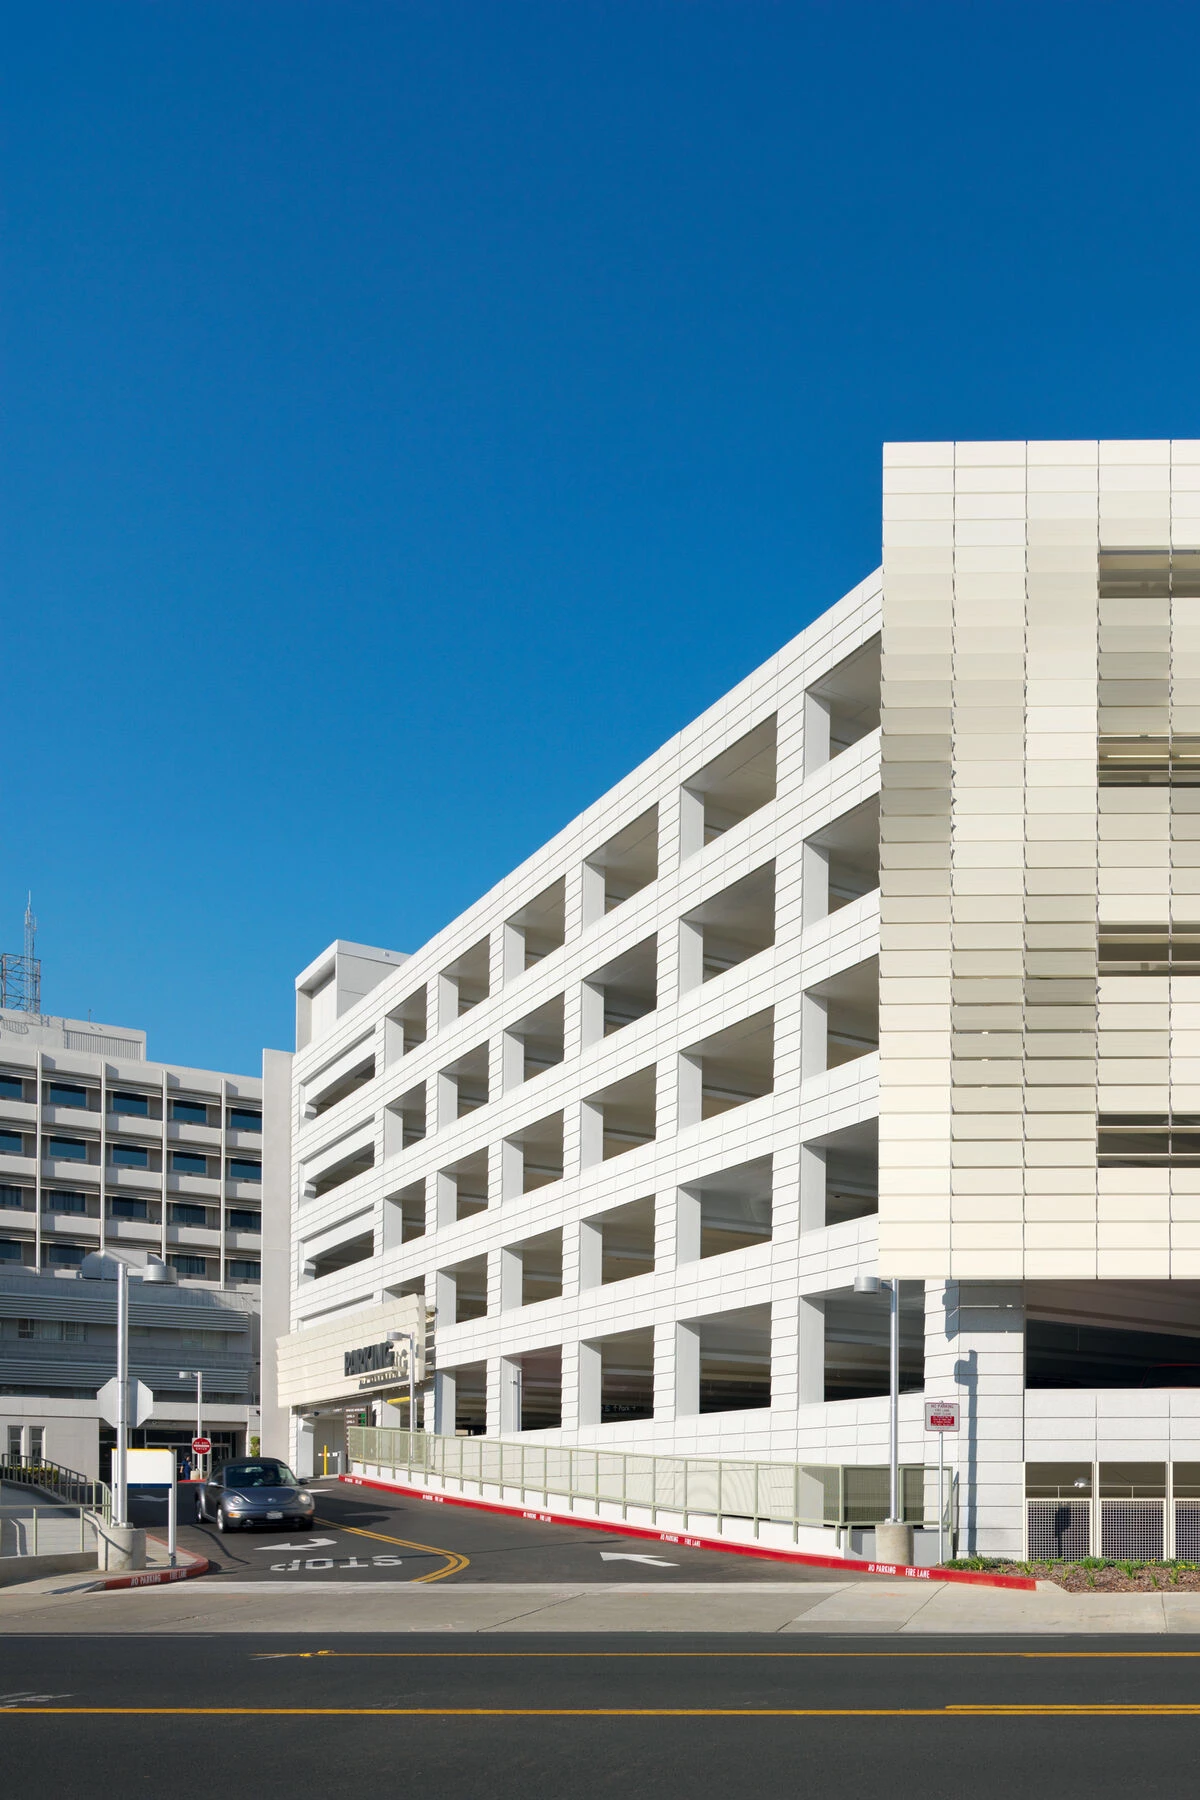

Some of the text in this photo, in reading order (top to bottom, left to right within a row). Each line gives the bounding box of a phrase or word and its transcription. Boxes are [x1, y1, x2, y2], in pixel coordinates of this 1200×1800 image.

[344, 1341, 396, 1377] PARKING
[270, 1555, 403, 1571] STOP
[868, 1563, 930, 1579] NO PARKING FIRE LANE
[130, 1577, 139, 1587] NO
[140, 1574, 162, 1585] PARKING
